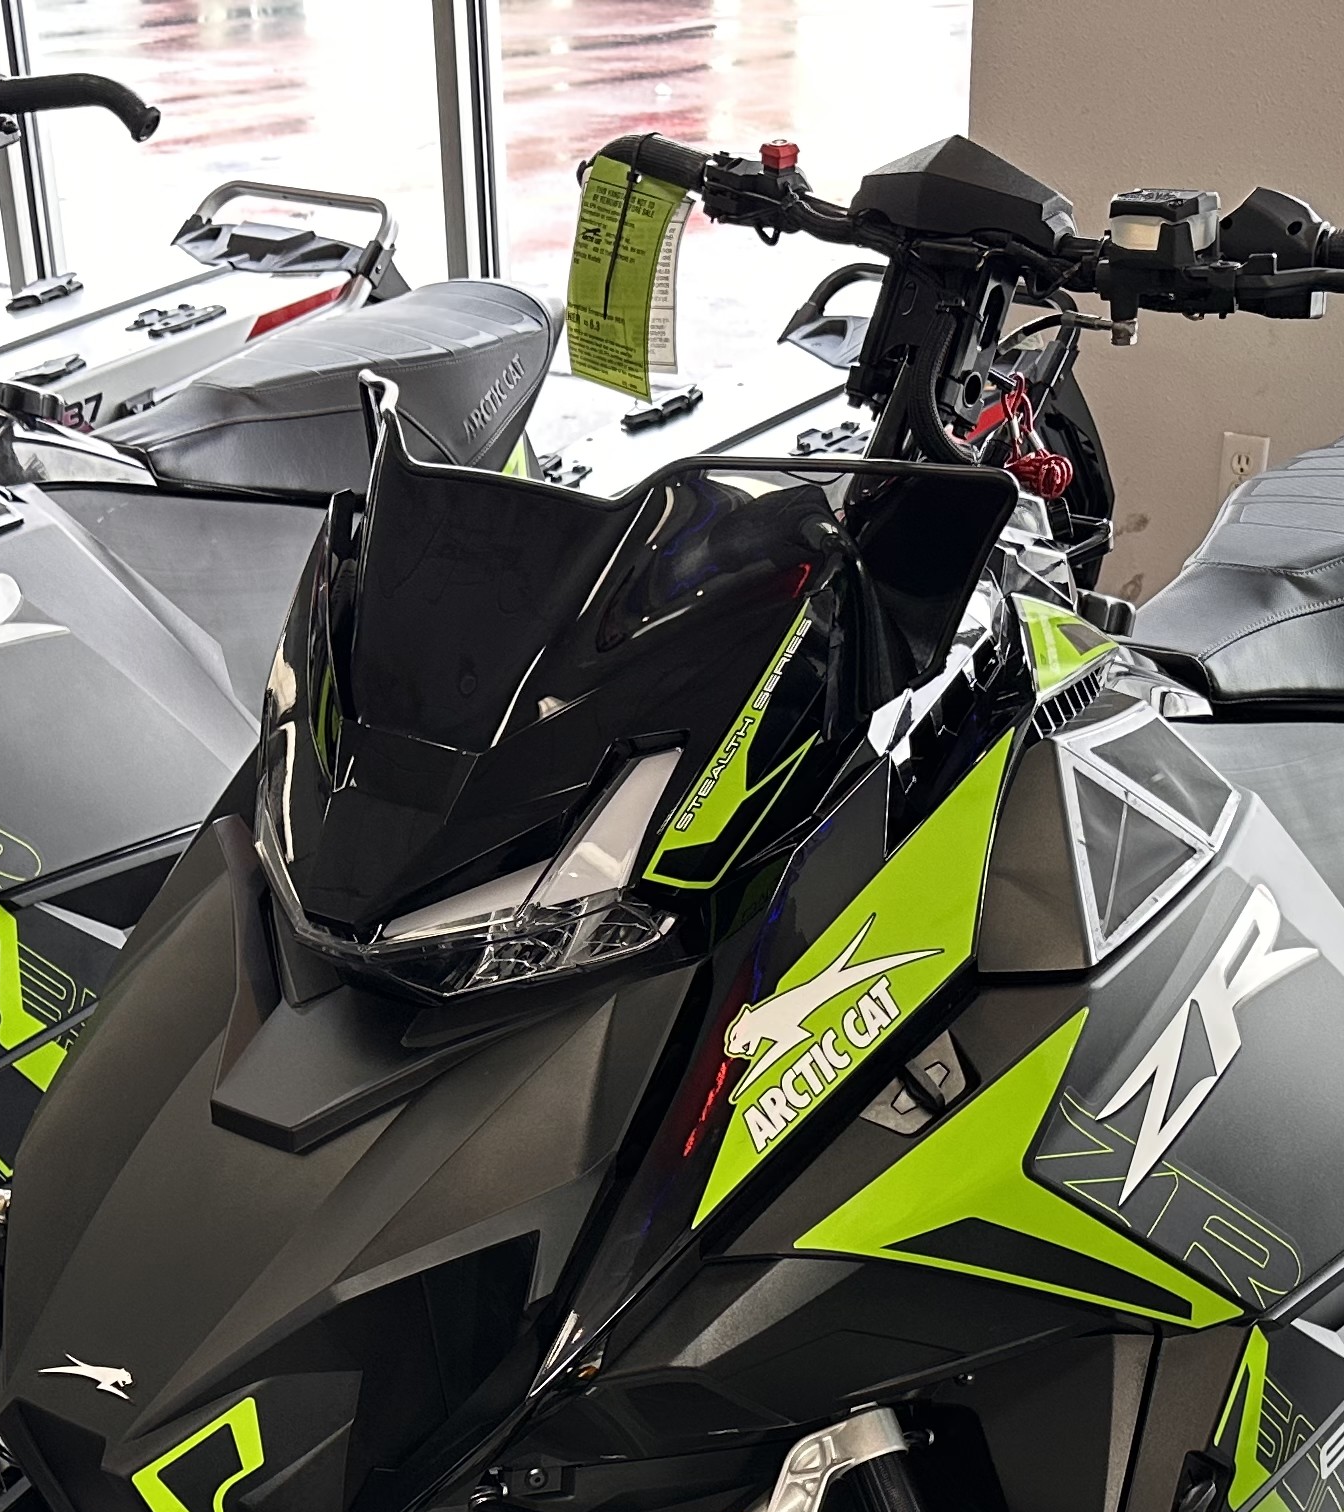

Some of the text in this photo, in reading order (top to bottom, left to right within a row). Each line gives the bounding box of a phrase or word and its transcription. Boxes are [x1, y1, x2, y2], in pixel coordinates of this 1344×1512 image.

[463, 353, 525, 445] ARCTIC CAT
[675, 617, 813, 832] STEALTH SERIES
[742, 973, 902, 1154] ARCTIC CAT
[1094, 883, 1321, 1208] ZR
